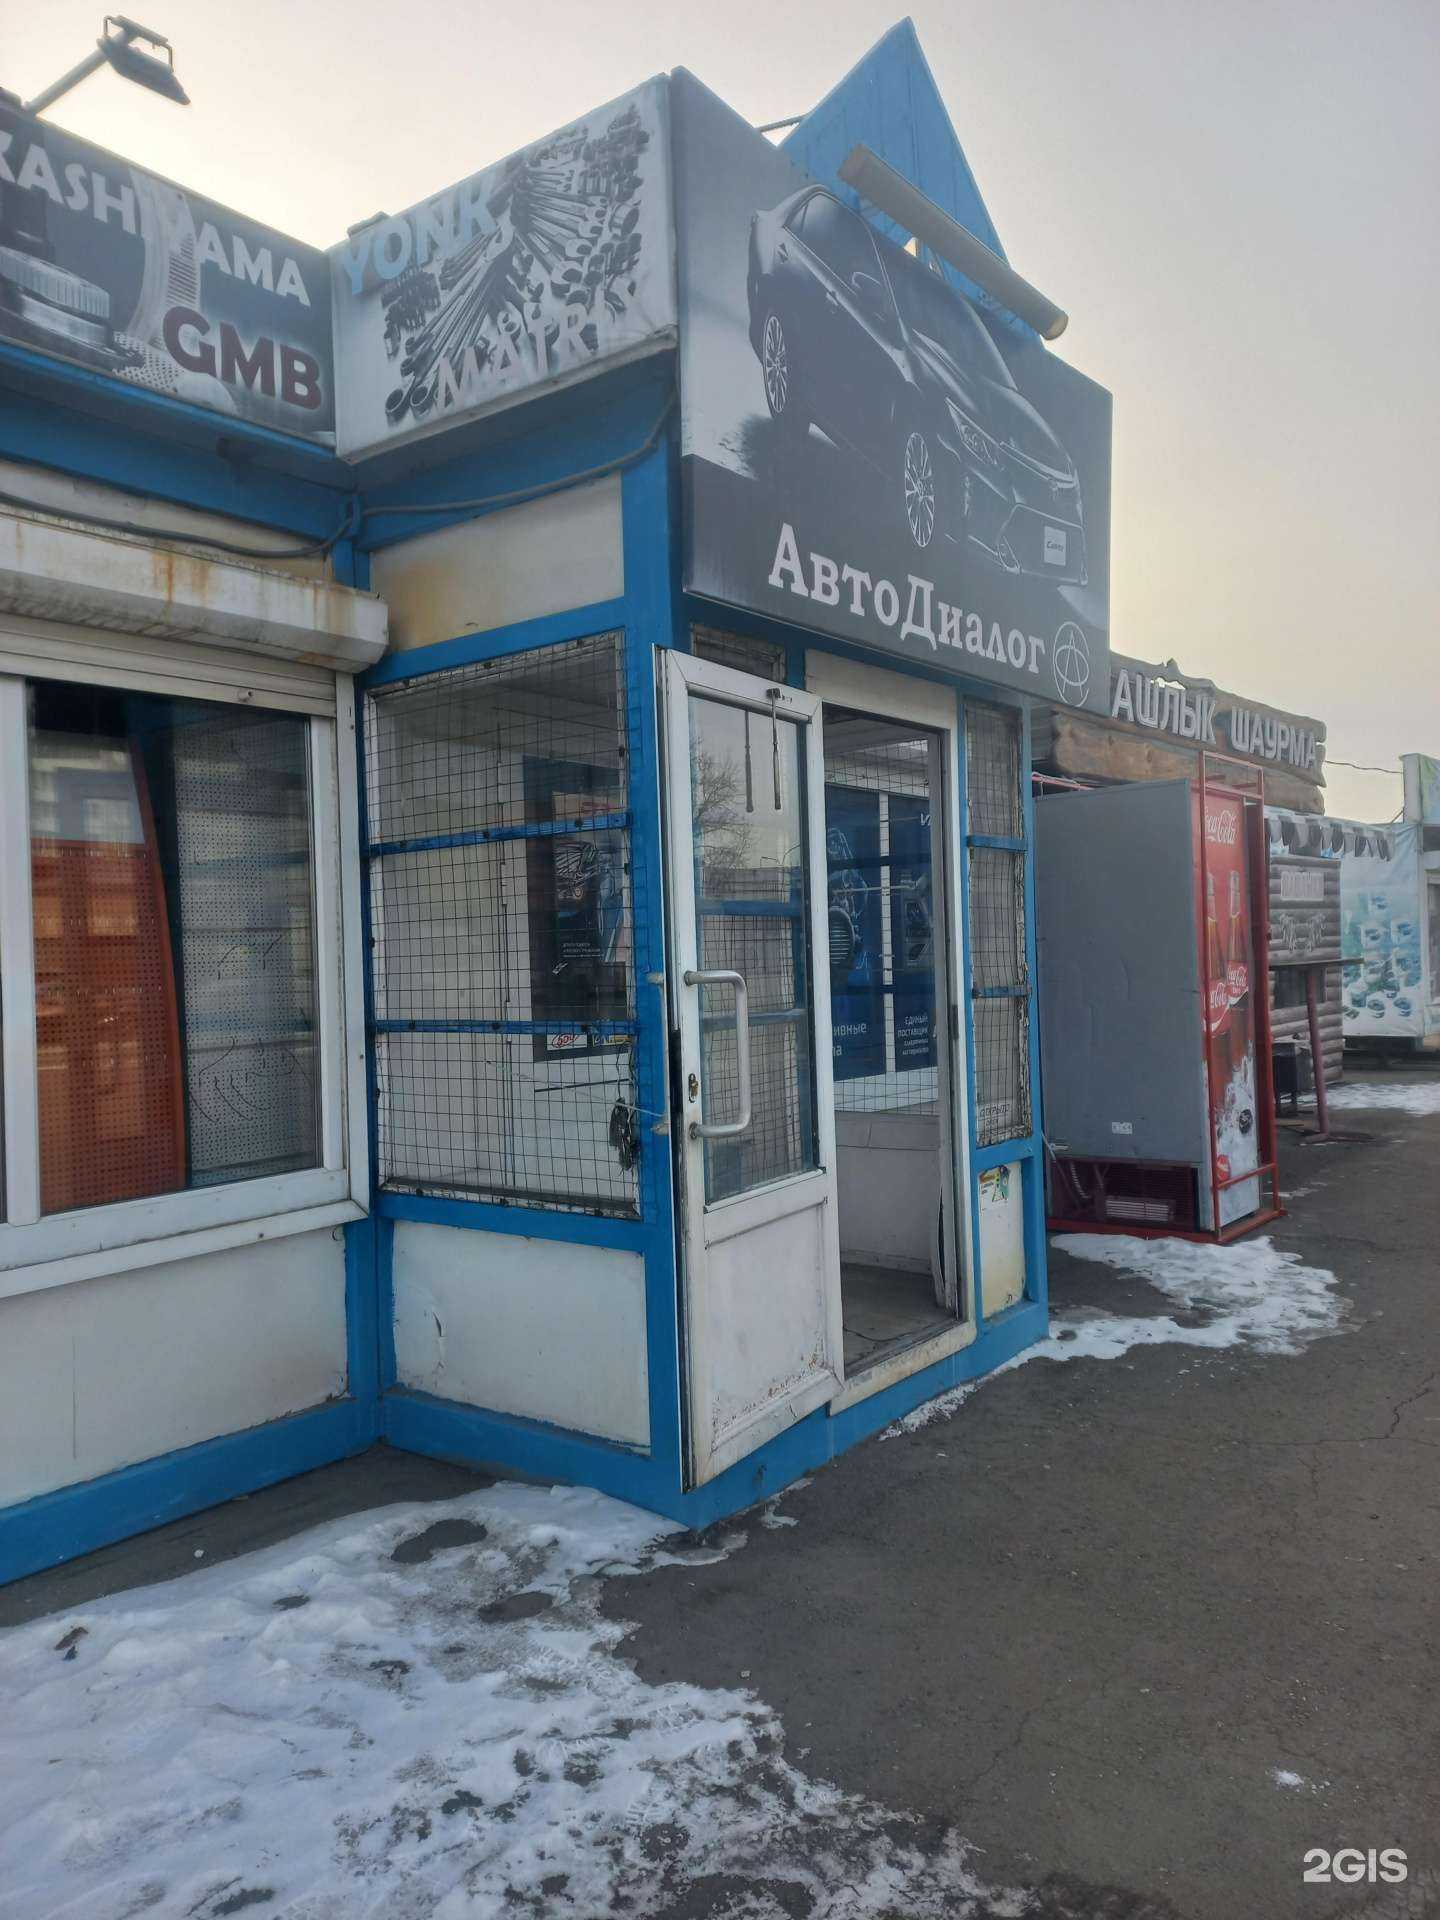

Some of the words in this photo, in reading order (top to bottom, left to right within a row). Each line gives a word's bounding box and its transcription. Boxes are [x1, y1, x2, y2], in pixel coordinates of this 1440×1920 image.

[162, 305, 322, 411] GMB
[768, 522, 1046, 674] АвтоДиалог
[1111, 668, 1217, 745] АШЛЫК
[1230, 706, 1316, 769] ШАУРМА
